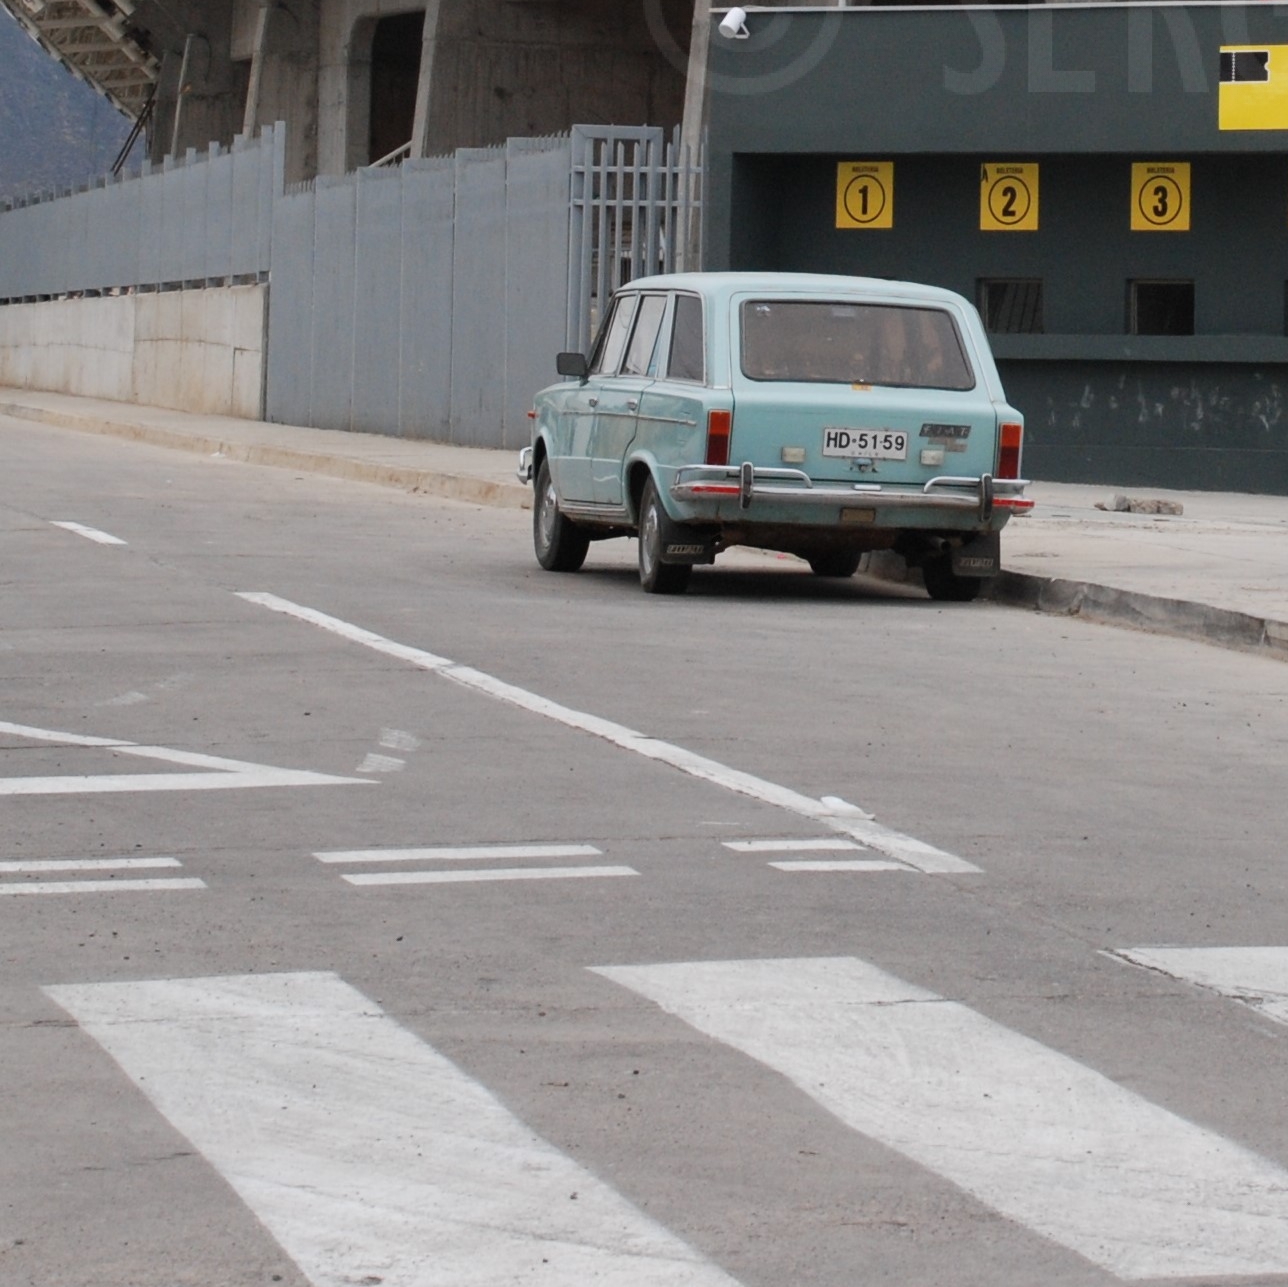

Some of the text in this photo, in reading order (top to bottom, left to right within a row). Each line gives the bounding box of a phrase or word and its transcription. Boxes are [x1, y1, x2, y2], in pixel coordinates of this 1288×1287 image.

[858, 185, 868, 215] 1
[1001, 186, 1017, 217] 2
[1152, 186, 1168, 217] 3
